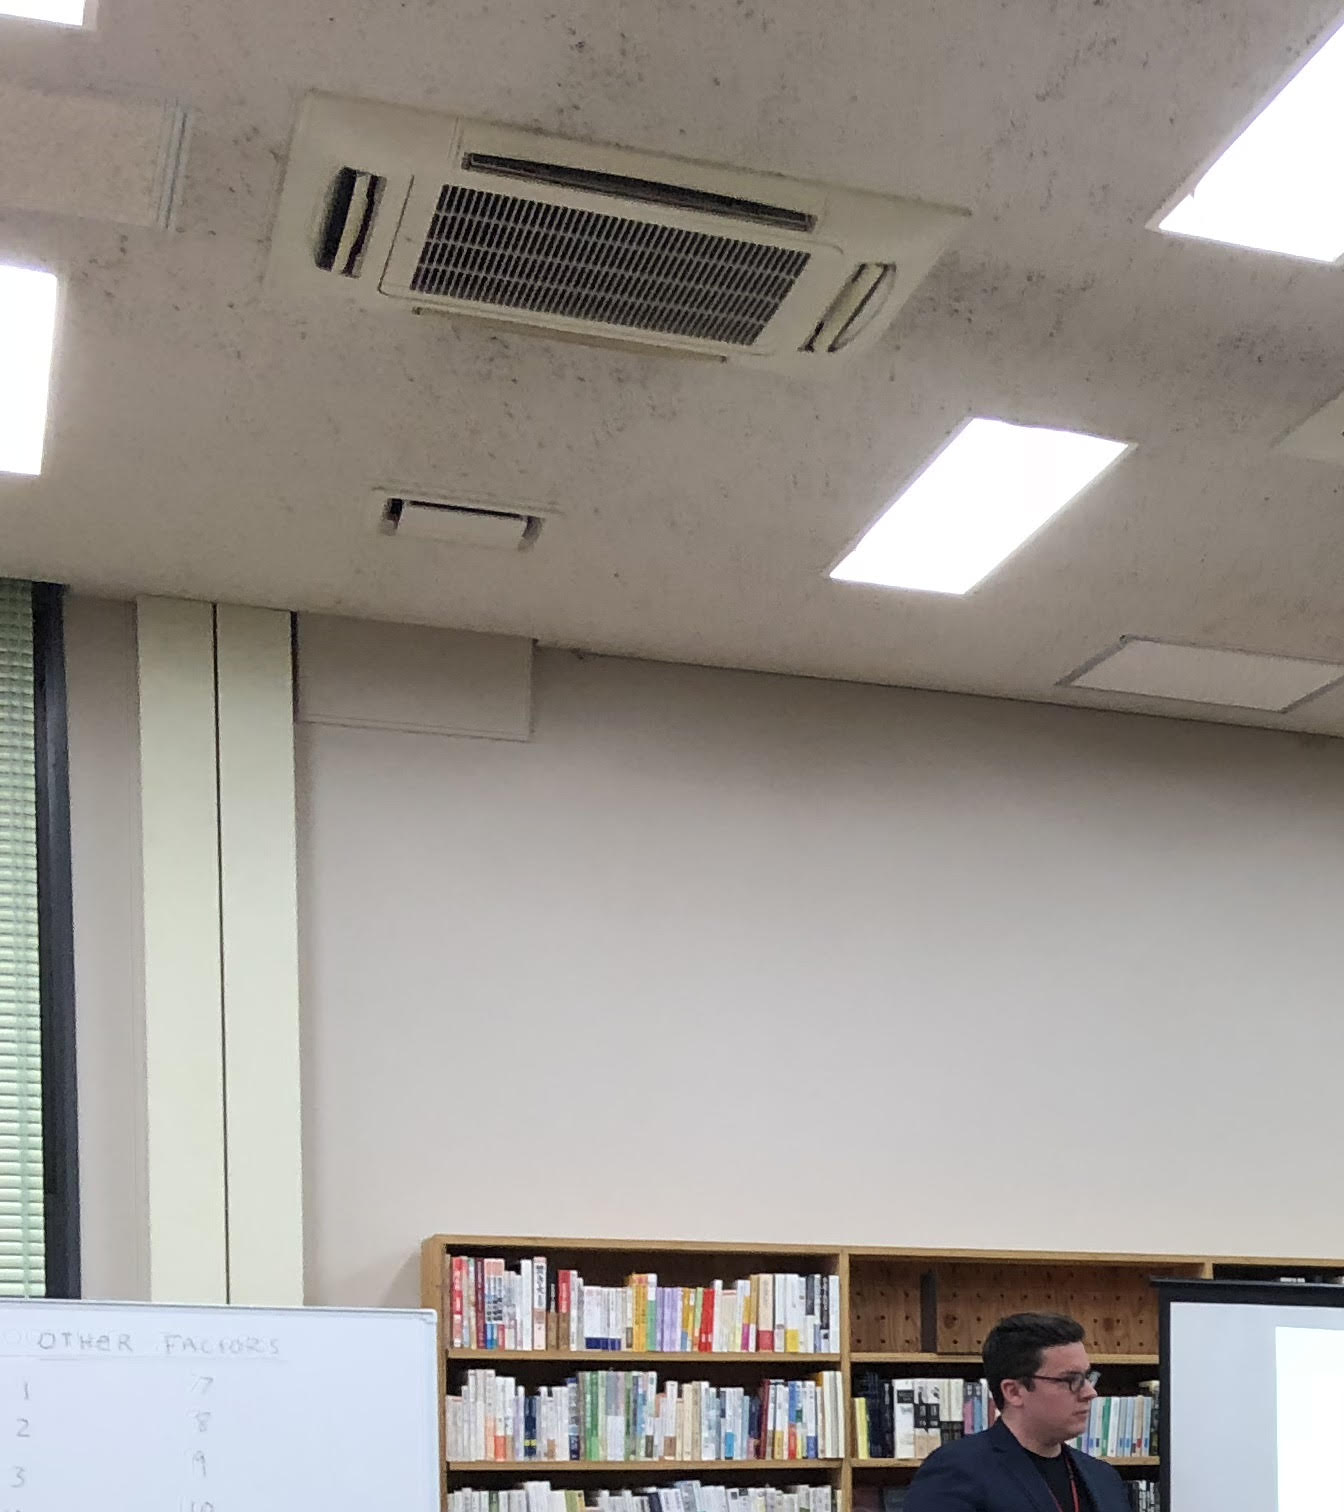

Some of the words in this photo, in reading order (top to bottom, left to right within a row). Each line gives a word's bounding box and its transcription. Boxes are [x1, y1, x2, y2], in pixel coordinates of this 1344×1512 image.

[164, 1335, 281, 1356] FACTORS
[15, 1417, 32, 1438] 2
[193, 1411, 212, 1433] 8
[191, 1449, 208, 1478] 9
[8, 1465, 27, 1489] 3
